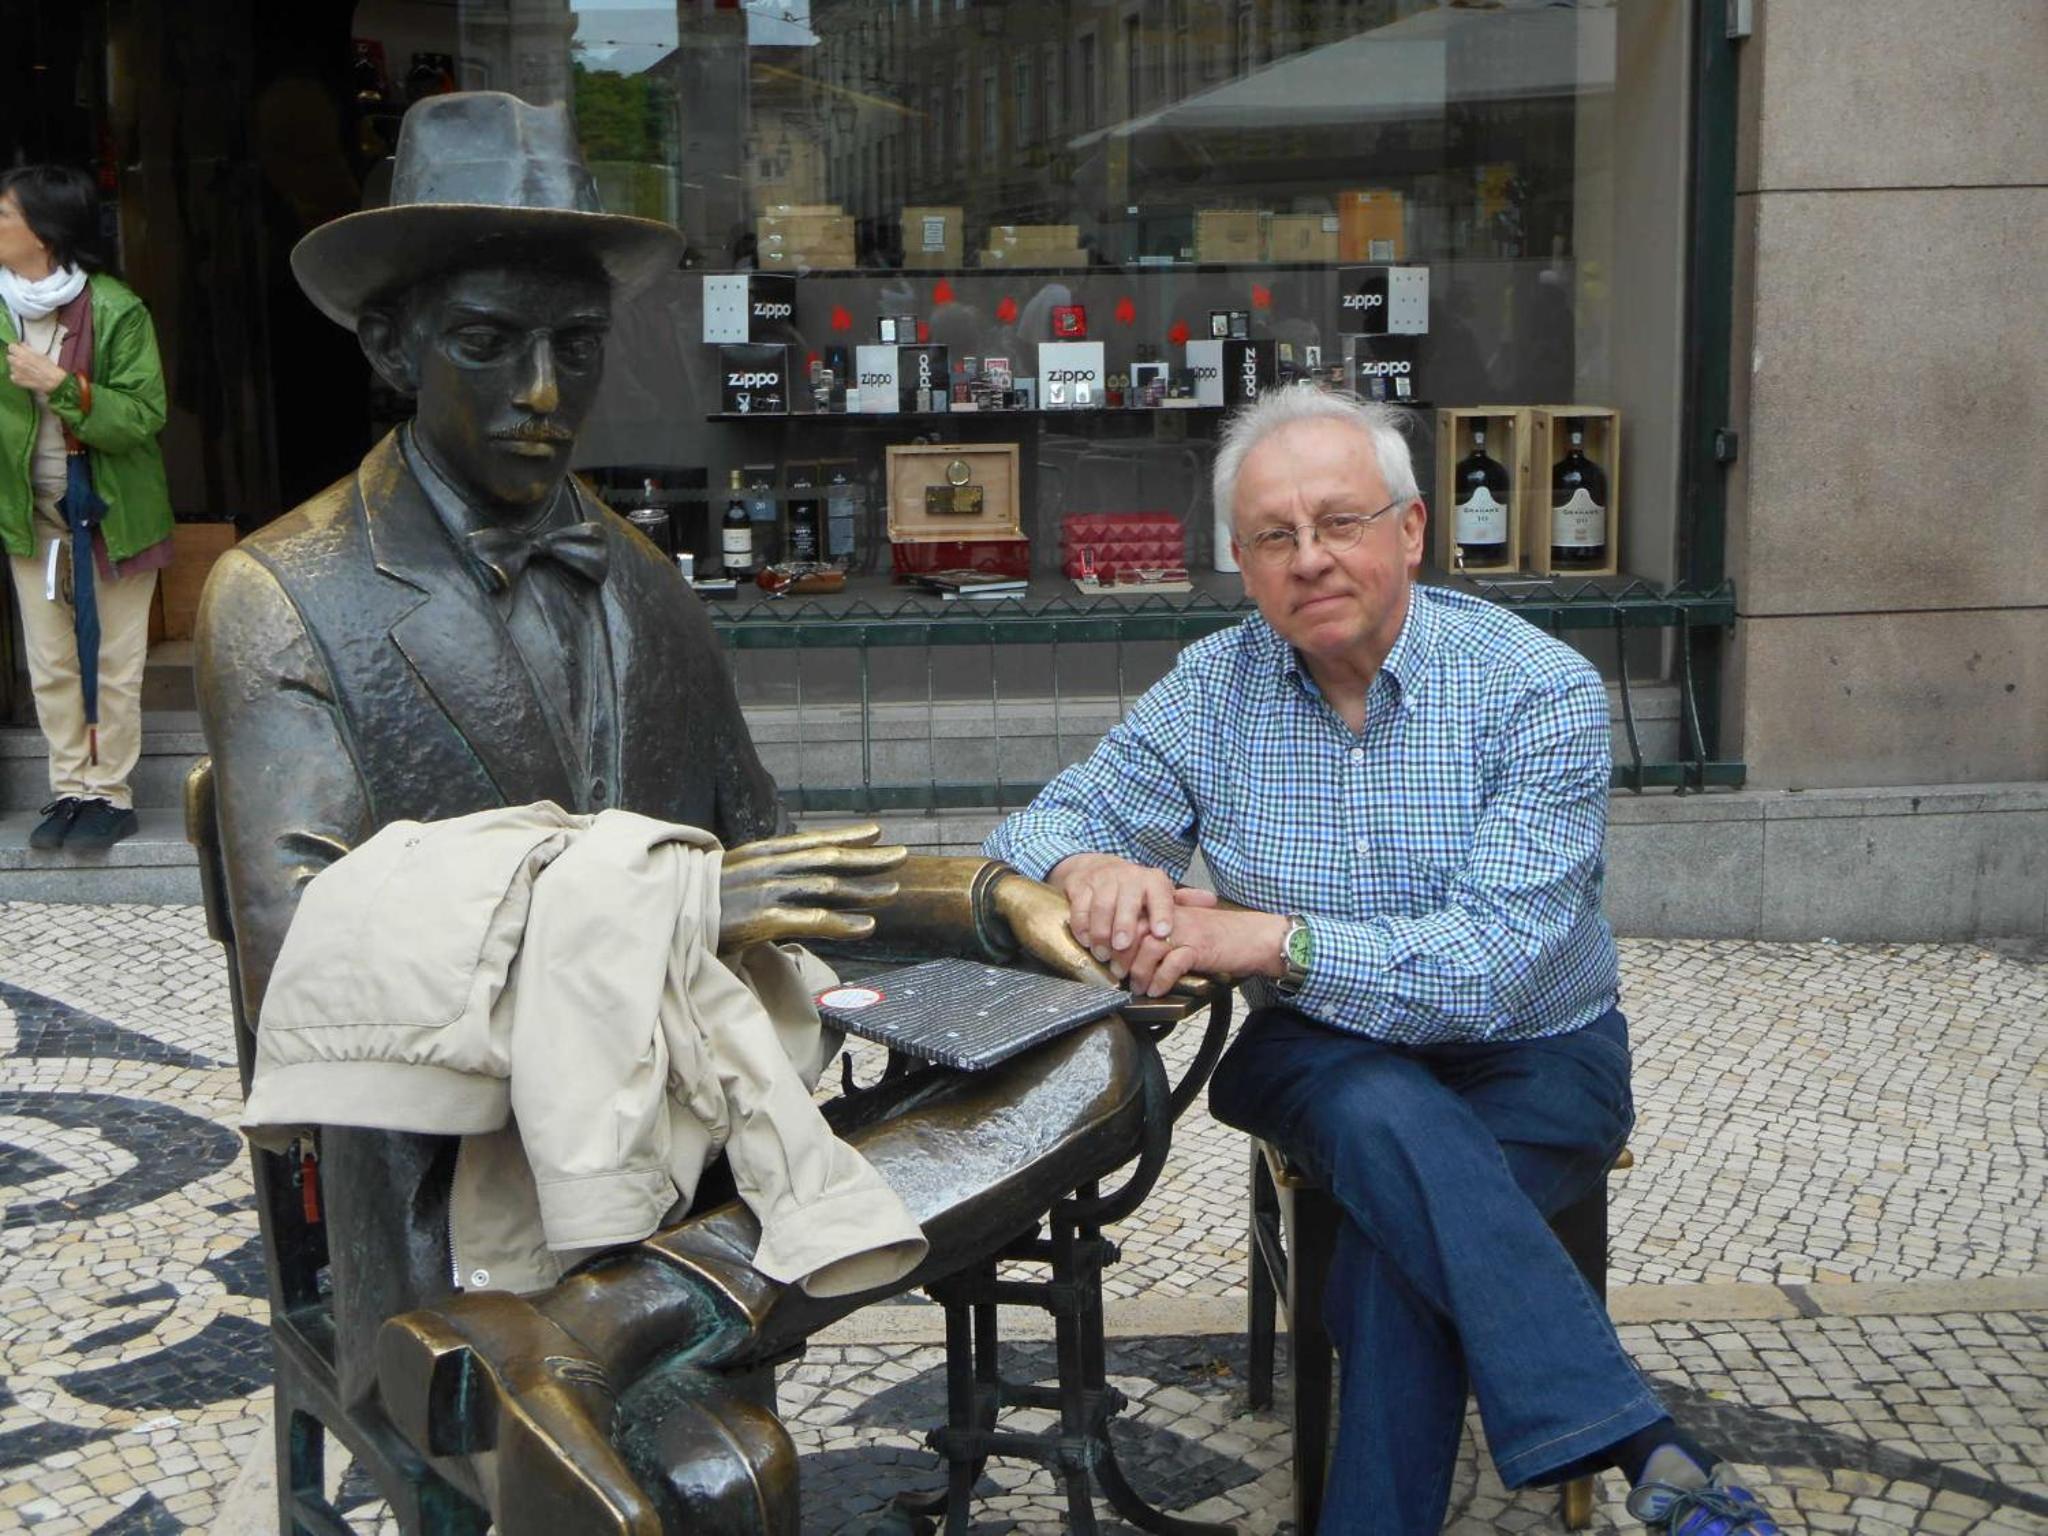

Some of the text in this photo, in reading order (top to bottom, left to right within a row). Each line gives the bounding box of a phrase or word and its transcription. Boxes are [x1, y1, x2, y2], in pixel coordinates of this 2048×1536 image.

[1343, 293, 1383, 310] zippo
[754, 302, 791, 319] zippo
[919, 354, 932, 392] ppo
[1047, 369, 1096, 384] zippo
[1193, 366, 1217, 382] ippo
[1243, 347, 1256, 397] zippo
[1362, 360, 1411, 377] zippo
[728, 370, 778, 388] zippo
[861, 372, 892, 388] zippo
